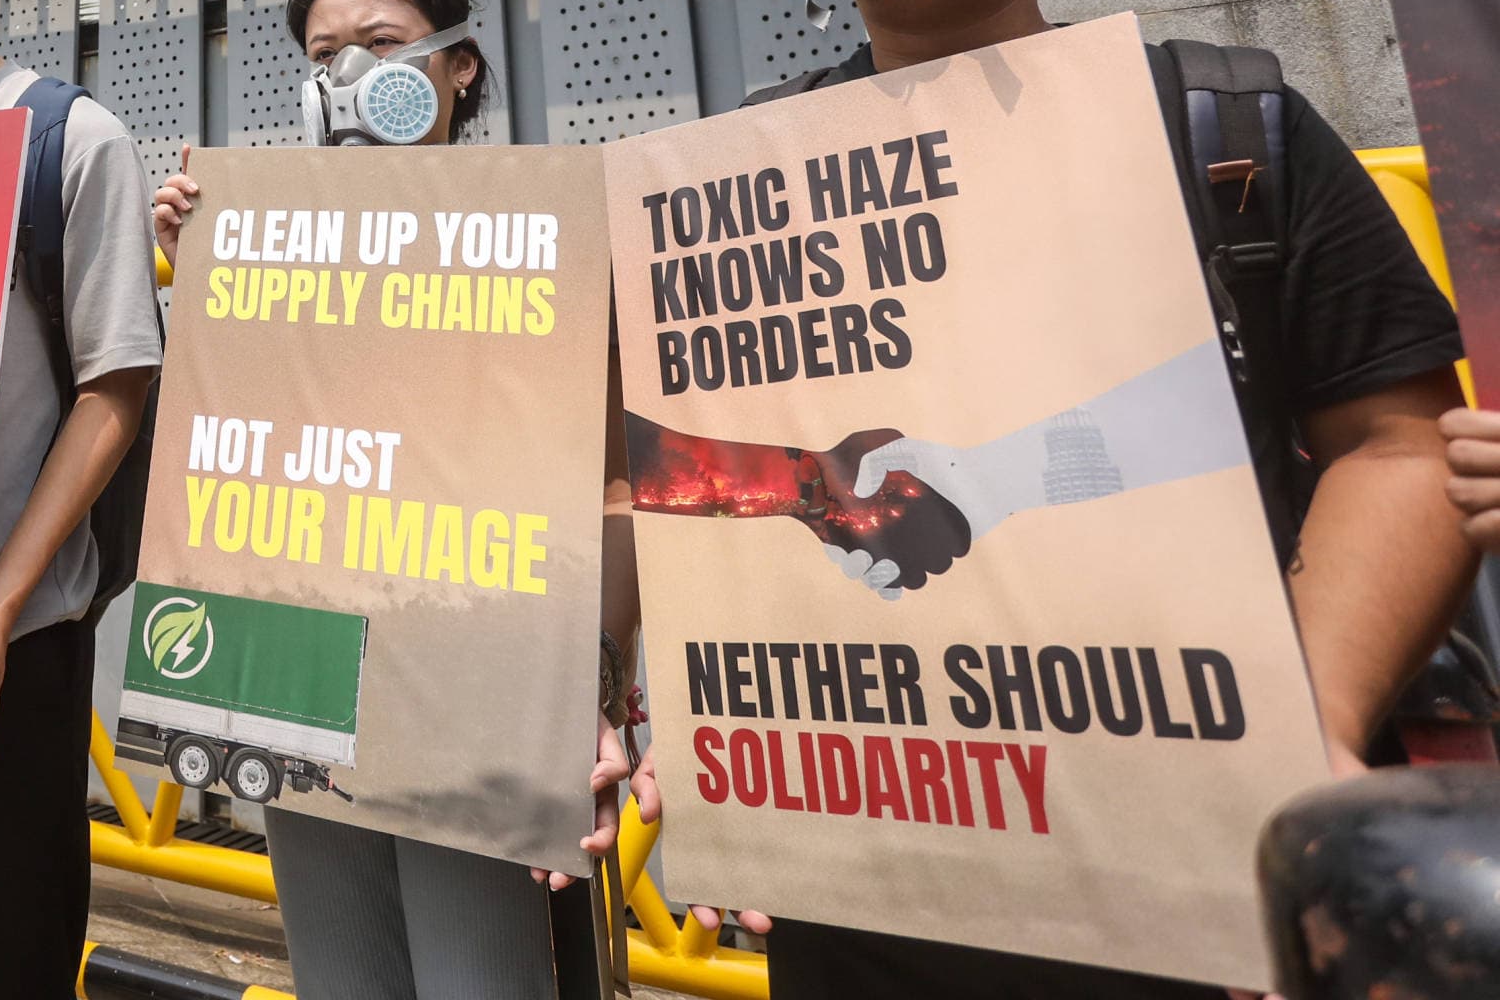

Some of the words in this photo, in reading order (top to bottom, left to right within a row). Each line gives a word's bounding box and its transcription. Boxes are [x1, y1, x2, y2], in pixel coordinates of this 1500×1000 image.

[211, 206, 346, 265] CLEAN
[357, 209, 419, 266] UP
[434, 210, 562, 271] YOUR
[643, 168, 790, 256] TOXIC
[806, 130, 957, 222] HAZE
[206, 266, 368, 325] SUPPLY
[379, 273, 556, 336] CHAINS
[651, 227, 849, 327] KNOWS
[861, 213, 946, 289] NO
[654, 294, 911, 395] BORDERS
[188, 414, 275, 479] NOT
[282, 423, 402, 492] JUST
[185, 475, 326, 564] YOUR
[343, 494, 549, 595] IMAGE
[686, 643, 927, 725] NEITHER
[944, 645, 1245, 740] SHOULD
[694, 727, 1049, 834] SOLIDARITY
